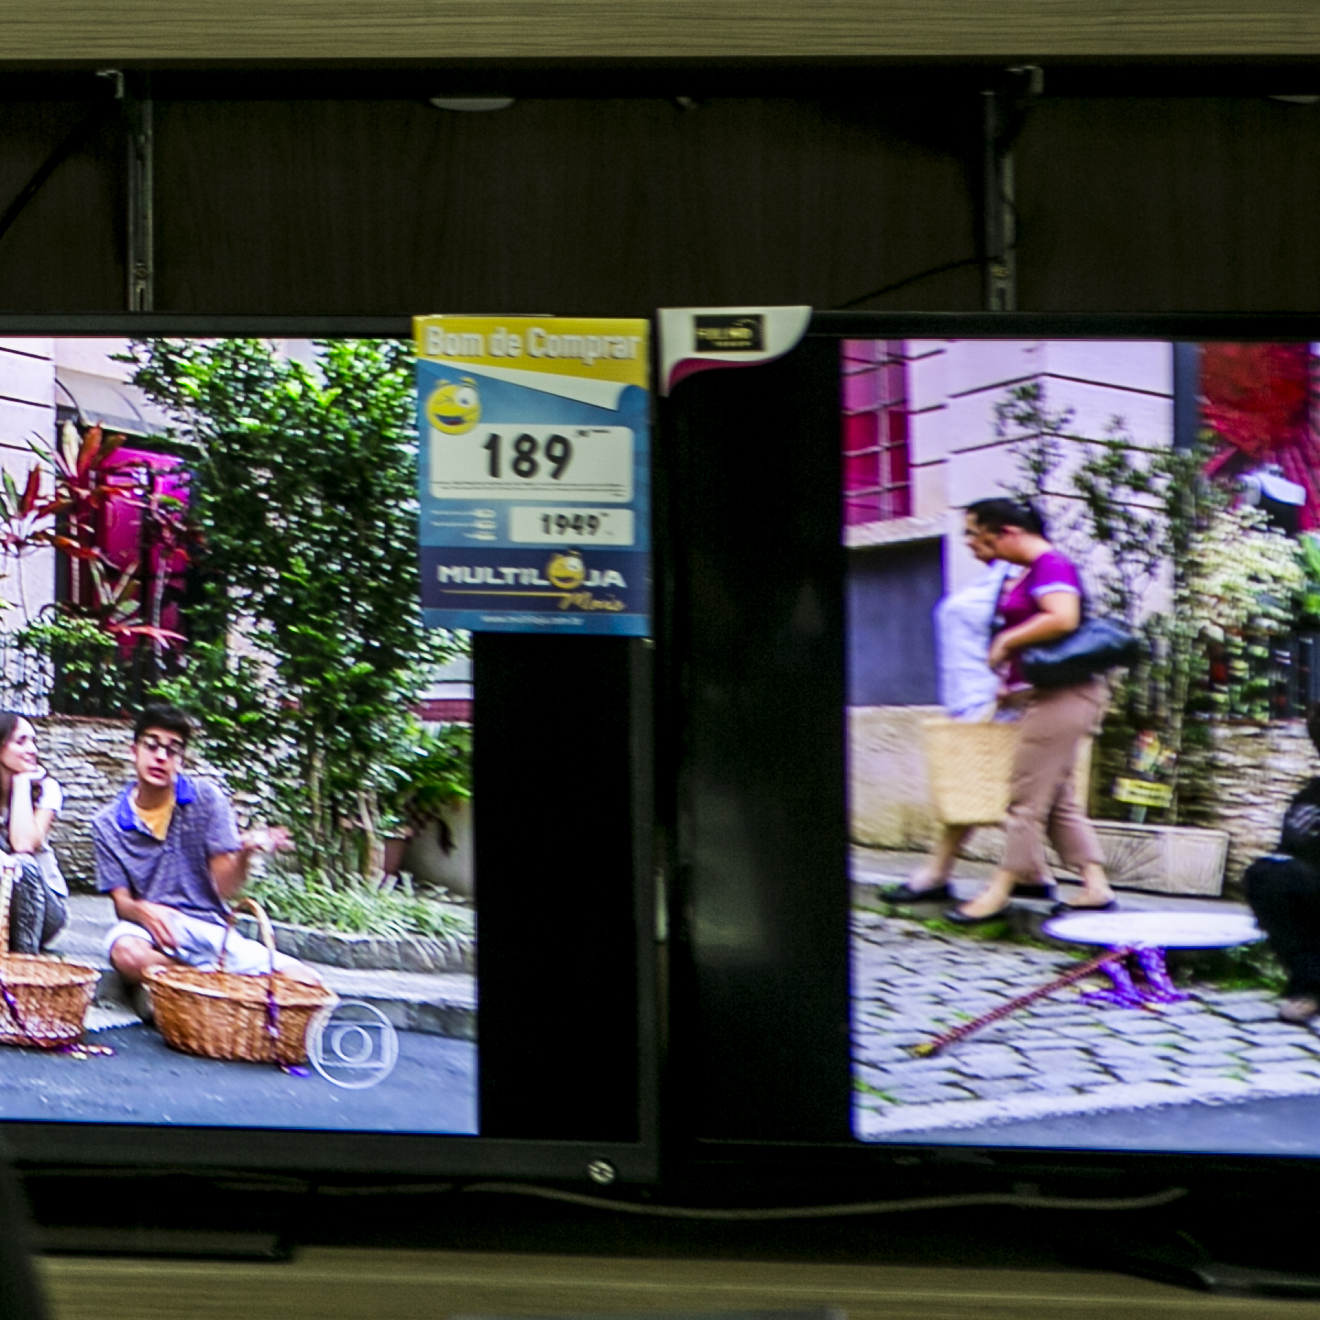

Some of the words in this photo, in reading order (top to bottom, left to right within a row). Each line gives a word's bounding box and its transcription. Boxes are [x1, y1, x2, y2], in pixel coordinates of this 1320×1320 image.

[424, 325, 484, 357] Bom
[488, 326, 523, 358] de
[526, 327, 642, 366] Comprar
[482, 433, 574, 480] 189
